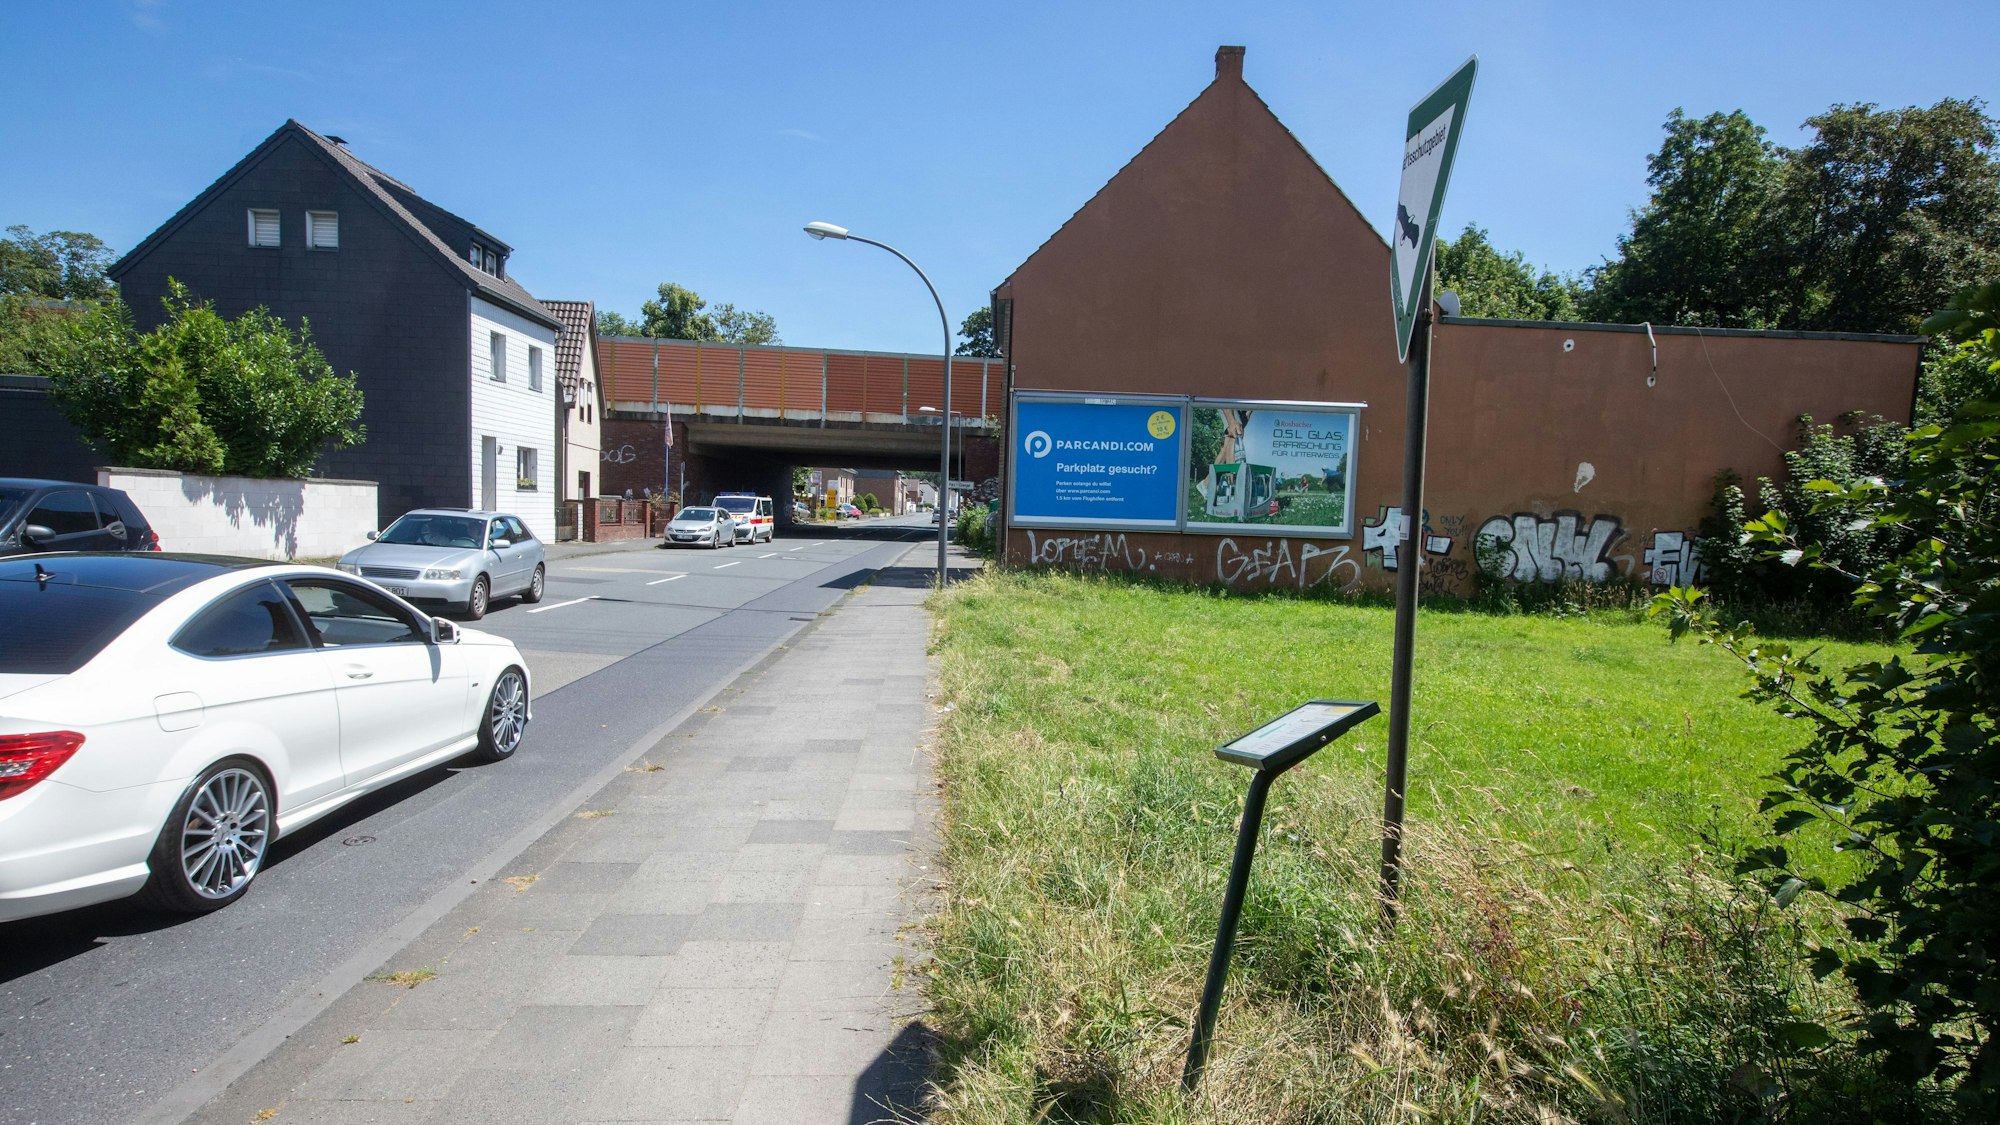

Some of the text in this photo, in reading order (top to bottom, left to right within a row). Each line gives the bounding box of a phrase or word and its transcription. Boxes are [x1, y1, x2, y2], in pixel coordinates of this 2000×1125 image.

[1308, 430, 1345, 441] GLAS:
[1056, 440, 1154, 452] PARCANDI.COM
[1272, 440, 1342, 451] ERFRISCHUNG
[1056, 462, 1158, 476] Parkplatz gesucht?
